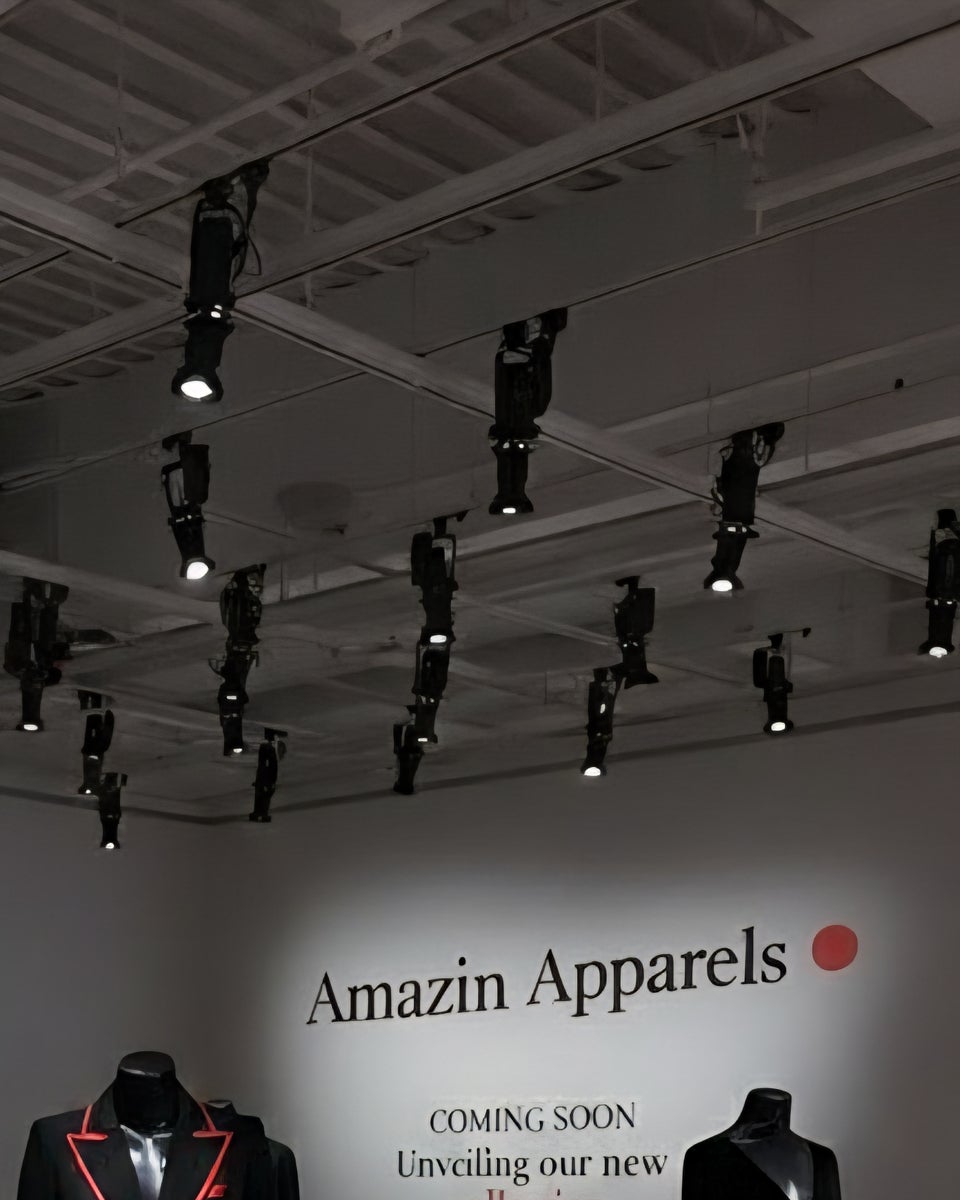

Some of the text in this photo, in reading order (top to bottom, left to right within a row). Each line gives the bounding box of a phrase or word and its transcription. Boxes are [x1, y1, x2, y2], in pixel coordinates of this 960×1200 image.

[305, 925, 788, 1026] Amazin Apparels
[429, 1101, 635, 1134] COMING SOON
[539, 1155, 593, 1177] our
[601, 1154, 669, 1177] new
